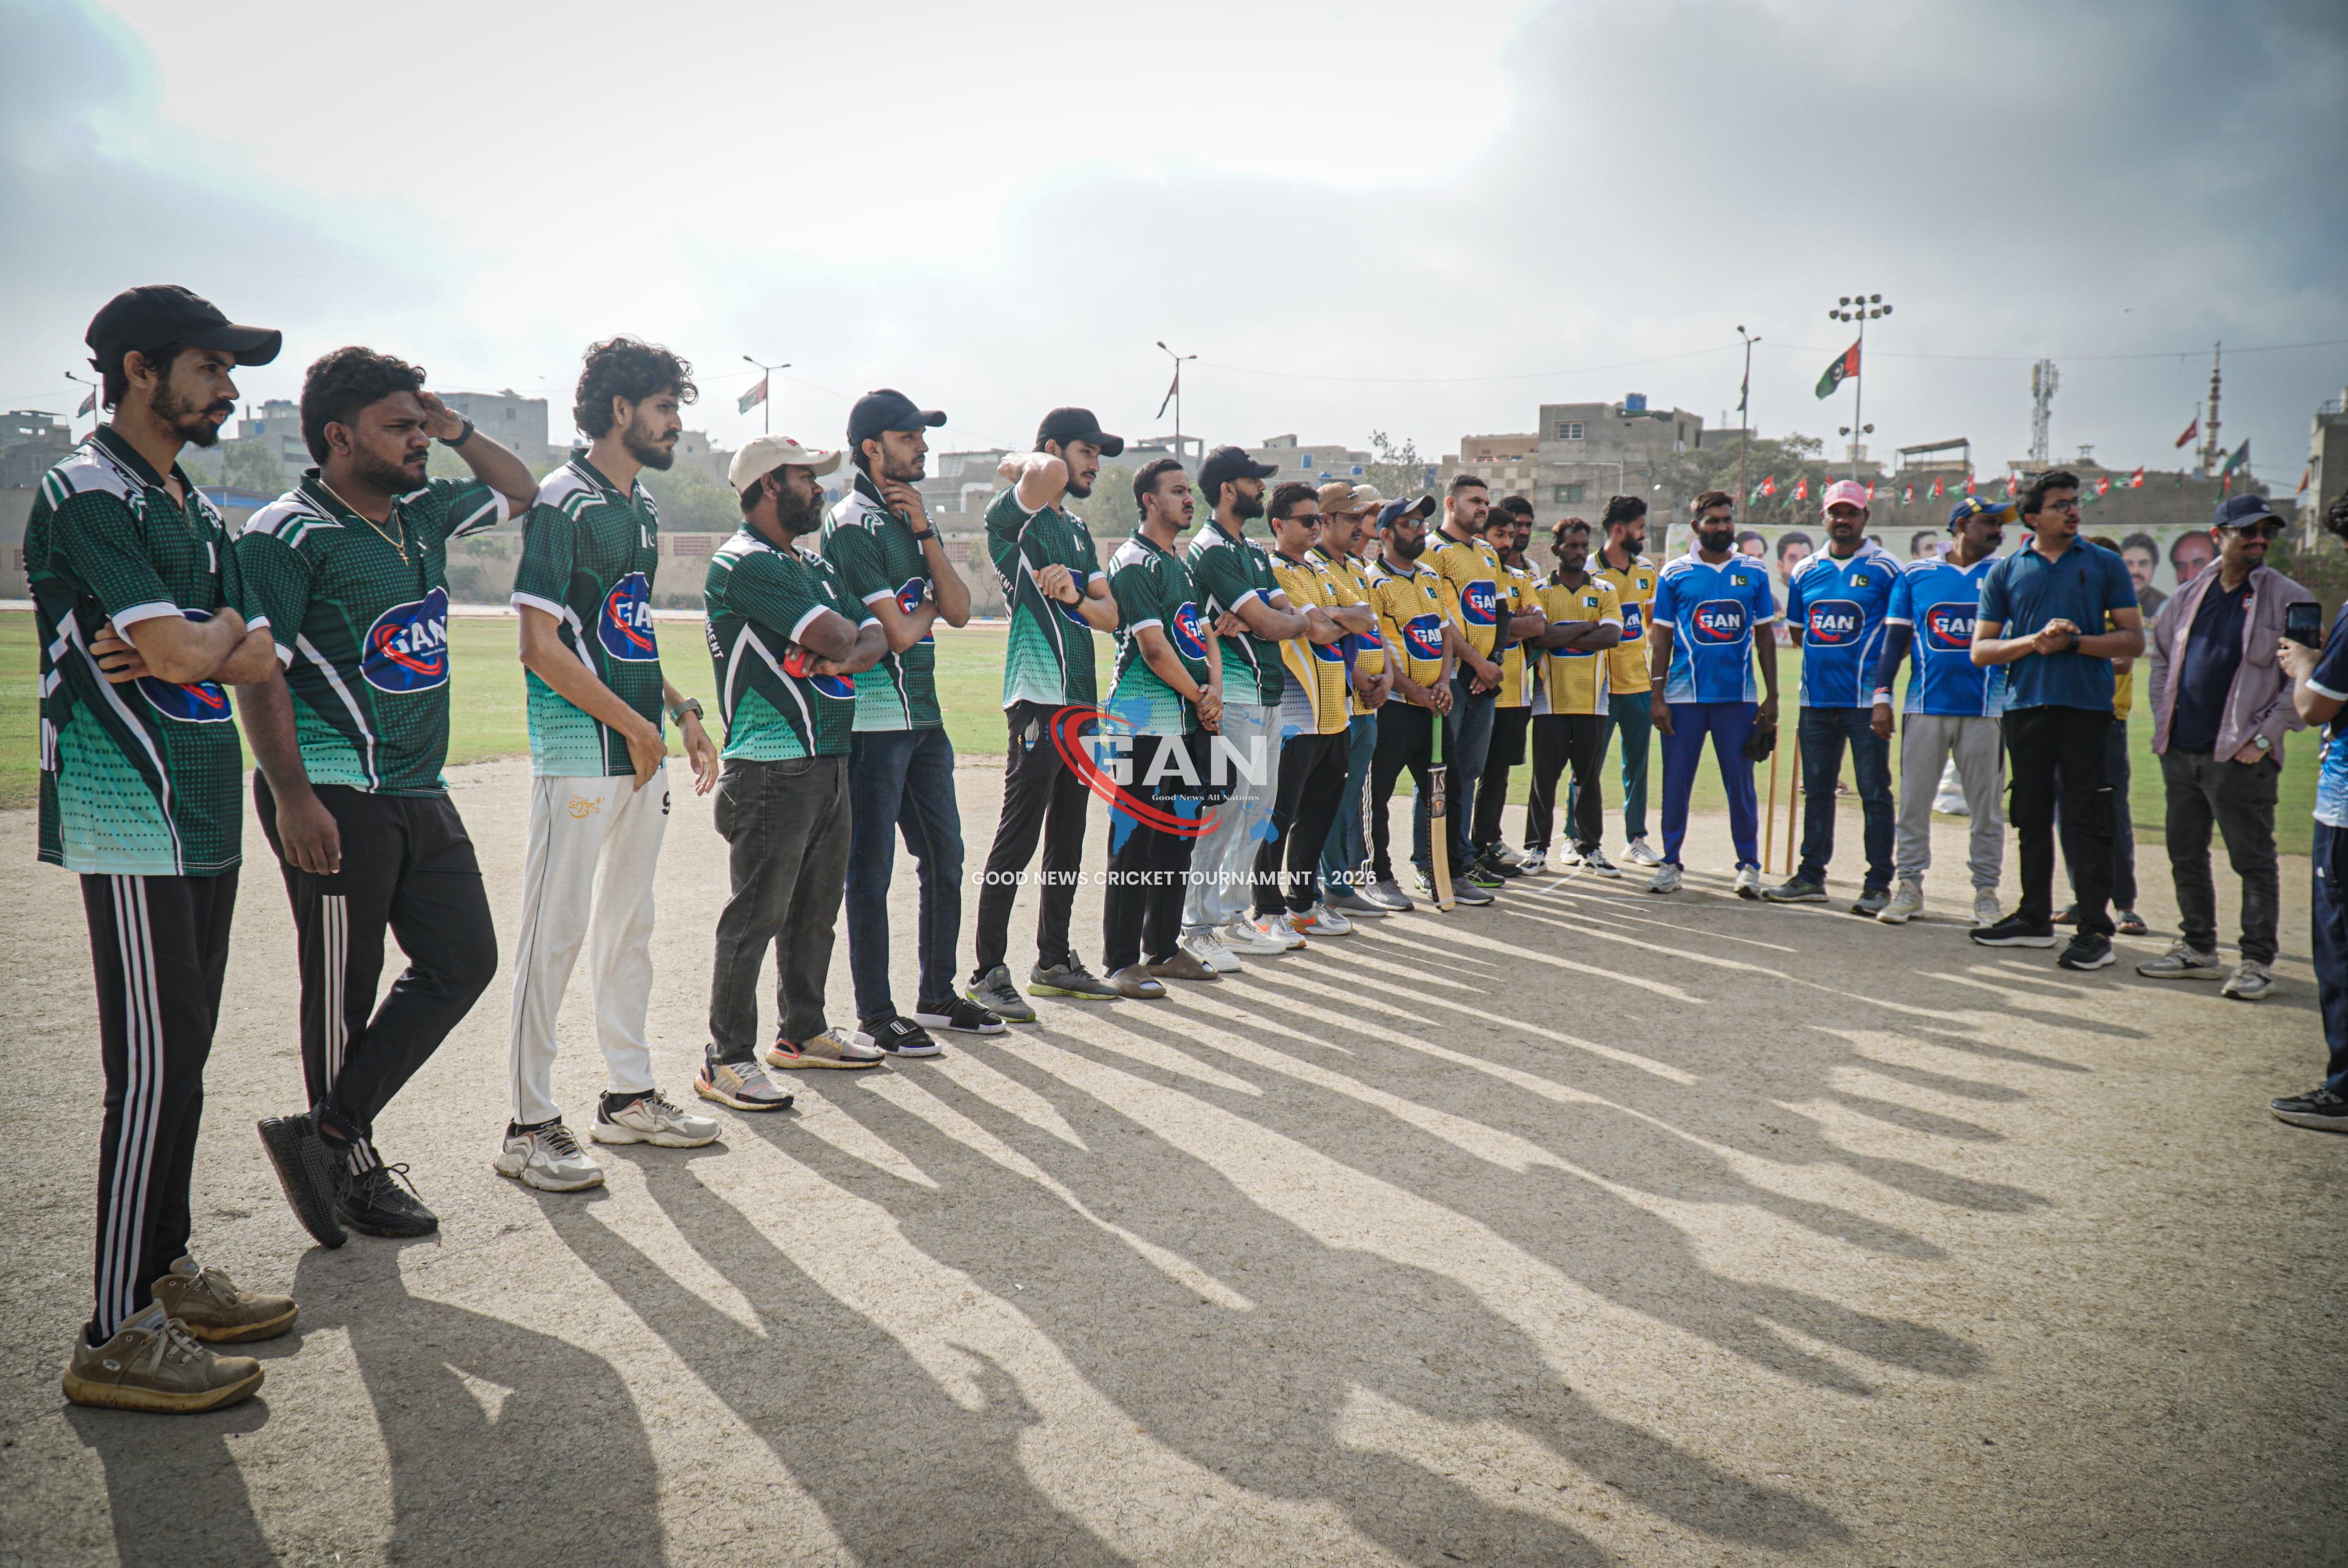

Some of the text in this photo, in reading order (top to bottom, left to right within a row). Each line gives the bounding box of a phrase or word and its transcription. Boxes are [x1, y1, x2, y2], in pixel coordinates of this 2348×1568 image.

[615, 601, 653, 628] GA
[1700, 614, 1740, 628] GAN
[1811, 615, 1855, 630] GAN
